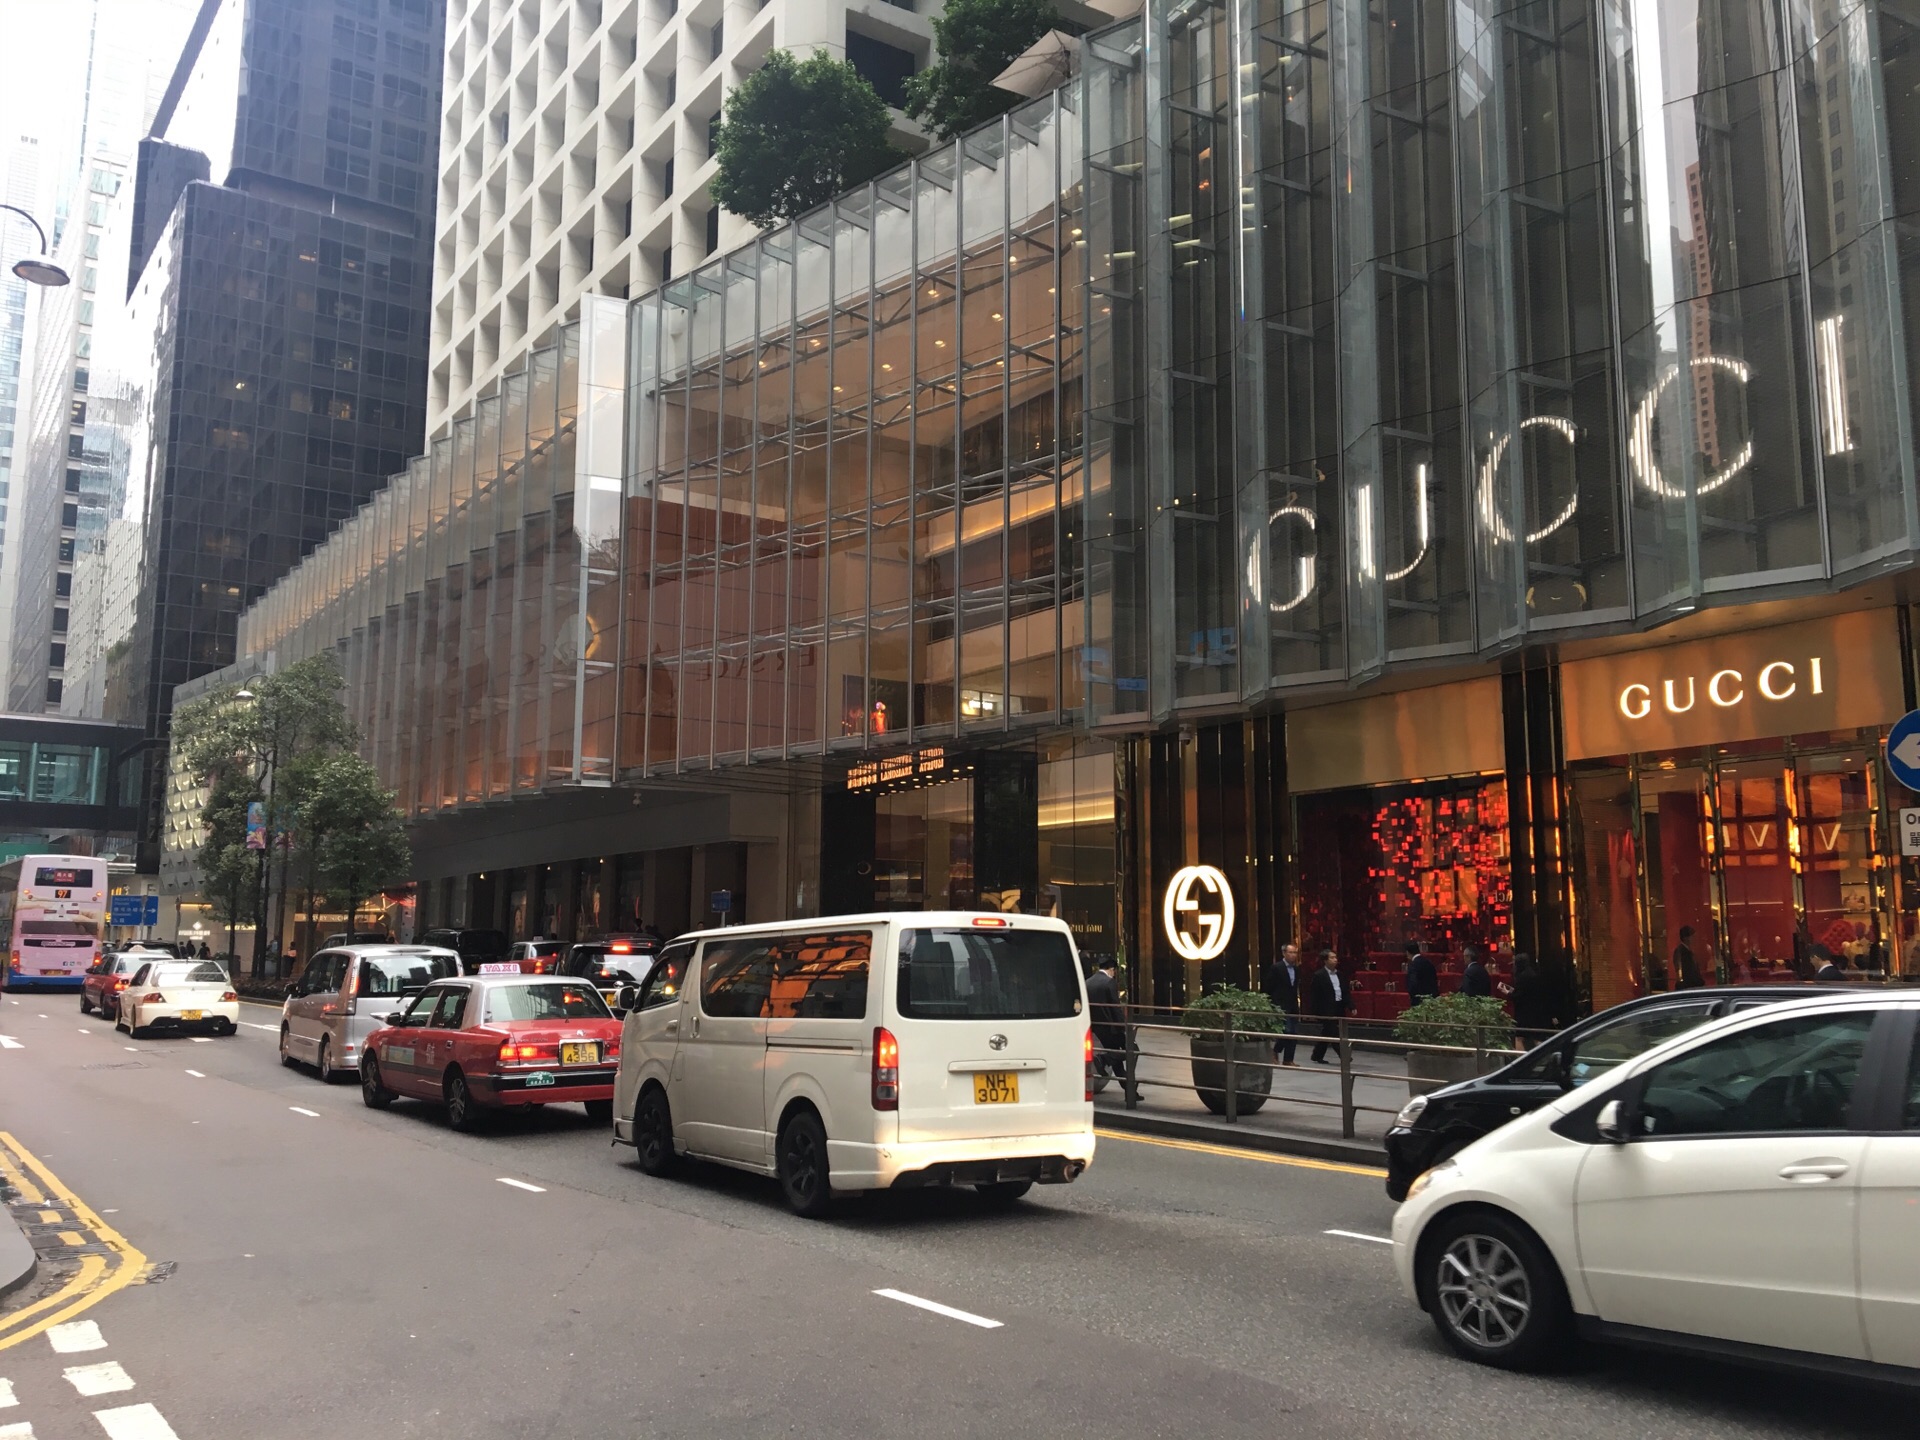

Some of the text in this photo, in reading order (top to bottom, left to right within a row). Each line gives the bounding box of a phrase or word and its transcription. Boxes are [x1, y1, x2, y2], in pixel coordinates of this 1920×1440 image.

[1246, 314, 1855, 612] GUCCI
[1619, 656, 1825, 720] GUCCI
[880, 765, 913, 781] LANDMARK
[57, 889, 68, 898] 97
[484, 964, 518, 973] TAXI
[566, 1052, 595, 1063] 4356
[986, 1074, 1007, 1089] NH
[978, 1087, 1016, 1102] 3071
